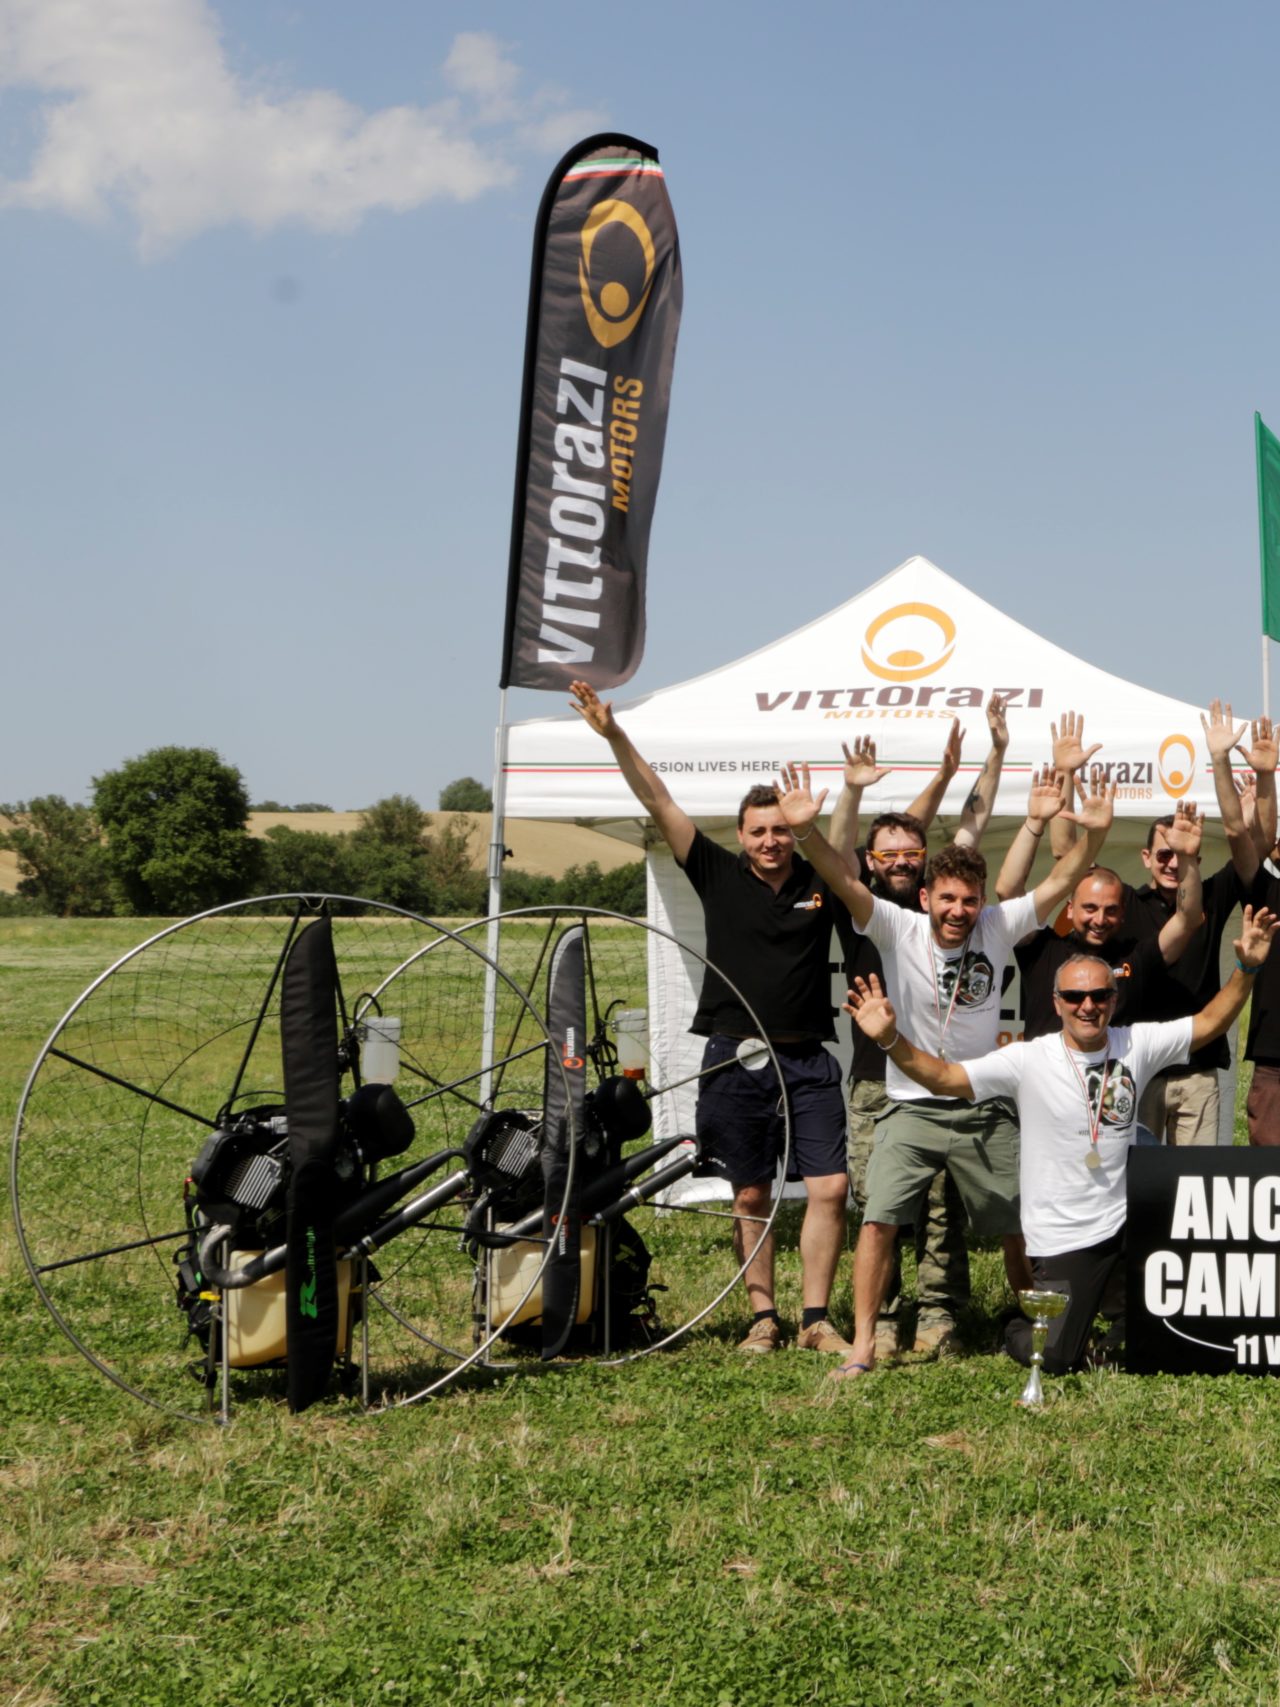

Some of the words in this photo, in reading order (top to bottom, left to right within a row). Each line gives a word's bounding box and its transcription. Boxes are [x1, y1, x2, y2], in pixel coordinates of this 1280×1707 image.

[611, 375, 644, 513] MOTORS
[823, 709, 957, 720] MOTORS
[650, 761, 694, 772] SSION
[698, 761, 737, 772] LIVES
[741, 760, 781, 772] HERE
[1233, 1335, 1260, 1365] 11
